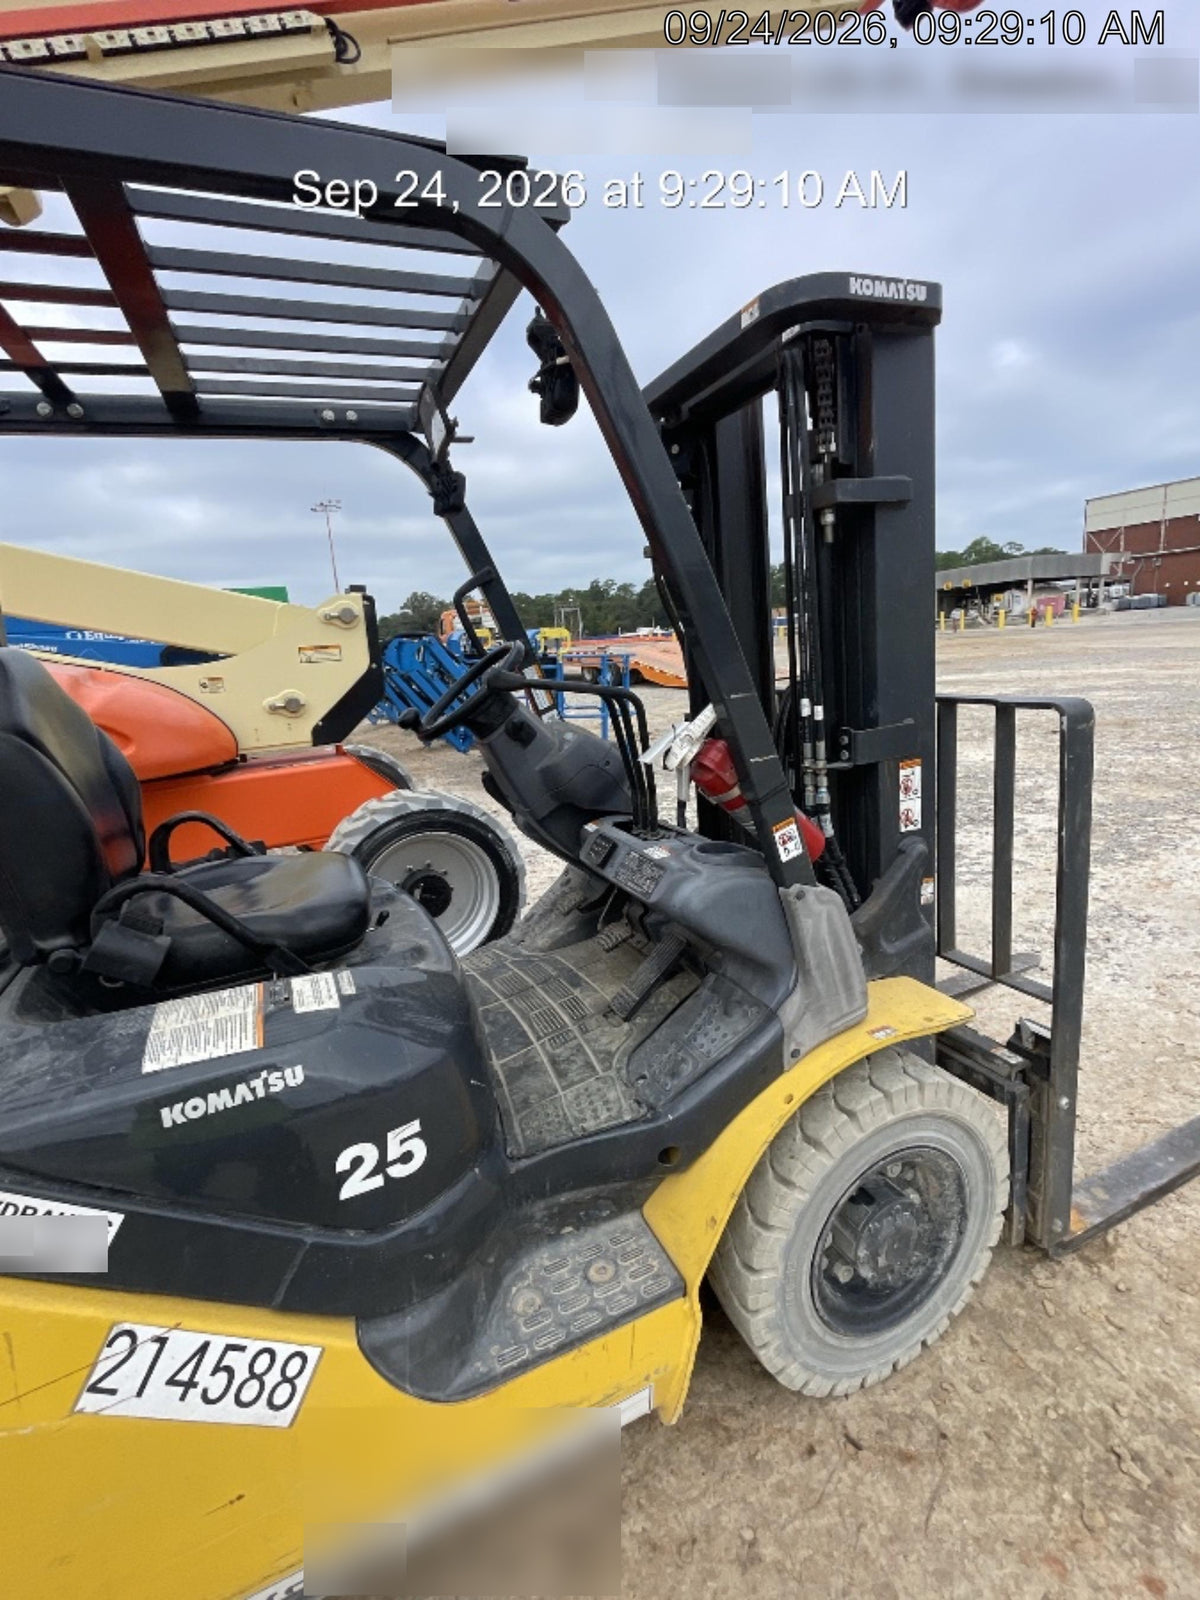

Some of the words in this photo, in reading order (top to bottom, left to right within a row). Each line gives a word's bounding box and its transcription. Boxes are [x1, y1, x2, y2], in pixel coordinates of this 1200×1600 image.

[849, 276, 928, 302] KOMATSU
[159, 1064, 306, 1129] KOMATSU
[335, 1118, 428, 1201] 25
[86, 1329, 309, 1412] 214588
